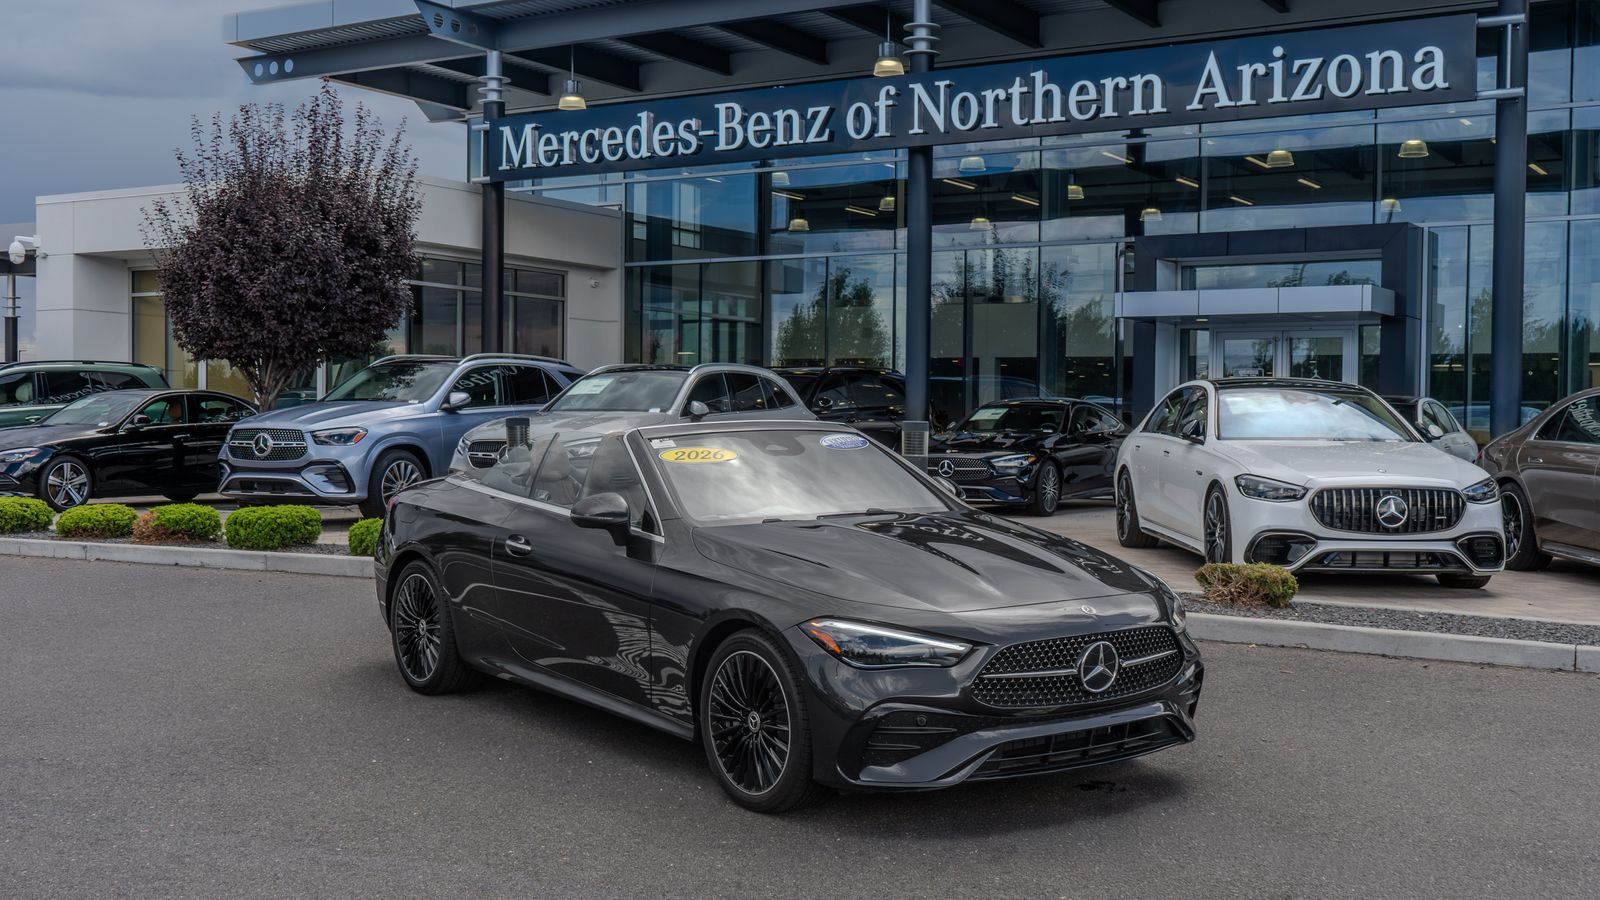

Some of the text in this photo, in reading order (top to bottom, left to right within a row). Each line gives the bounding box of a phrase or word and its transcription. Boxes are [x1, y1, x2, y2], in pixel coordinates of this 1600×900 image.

[498, 45, 1448, 171] Mercedes-Benz of Northern Arizona
[674, 450, 724, 461] 2026
